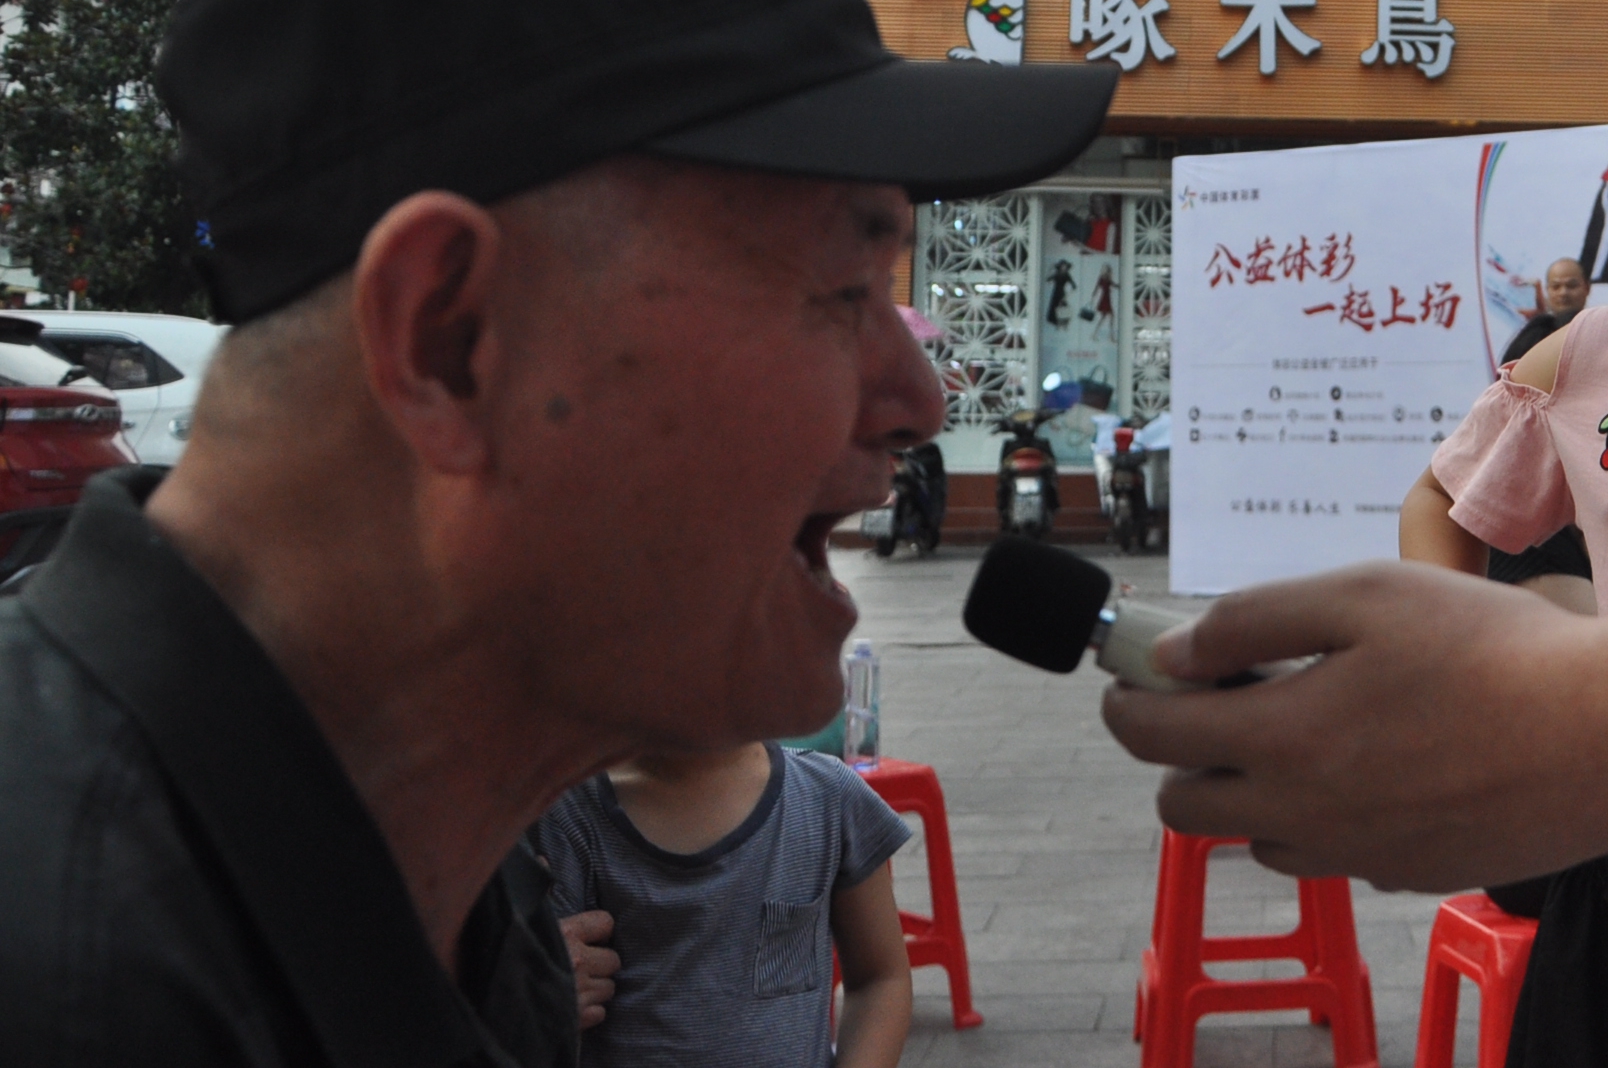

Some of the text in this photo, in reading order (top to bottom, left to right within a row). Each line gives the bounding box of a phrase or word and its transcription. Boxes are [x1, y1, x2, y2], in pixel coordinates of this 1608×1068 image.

[1204, 231, 1356, 289] 公益体彩
[1302, 282, 1461, 333] 一起上场
